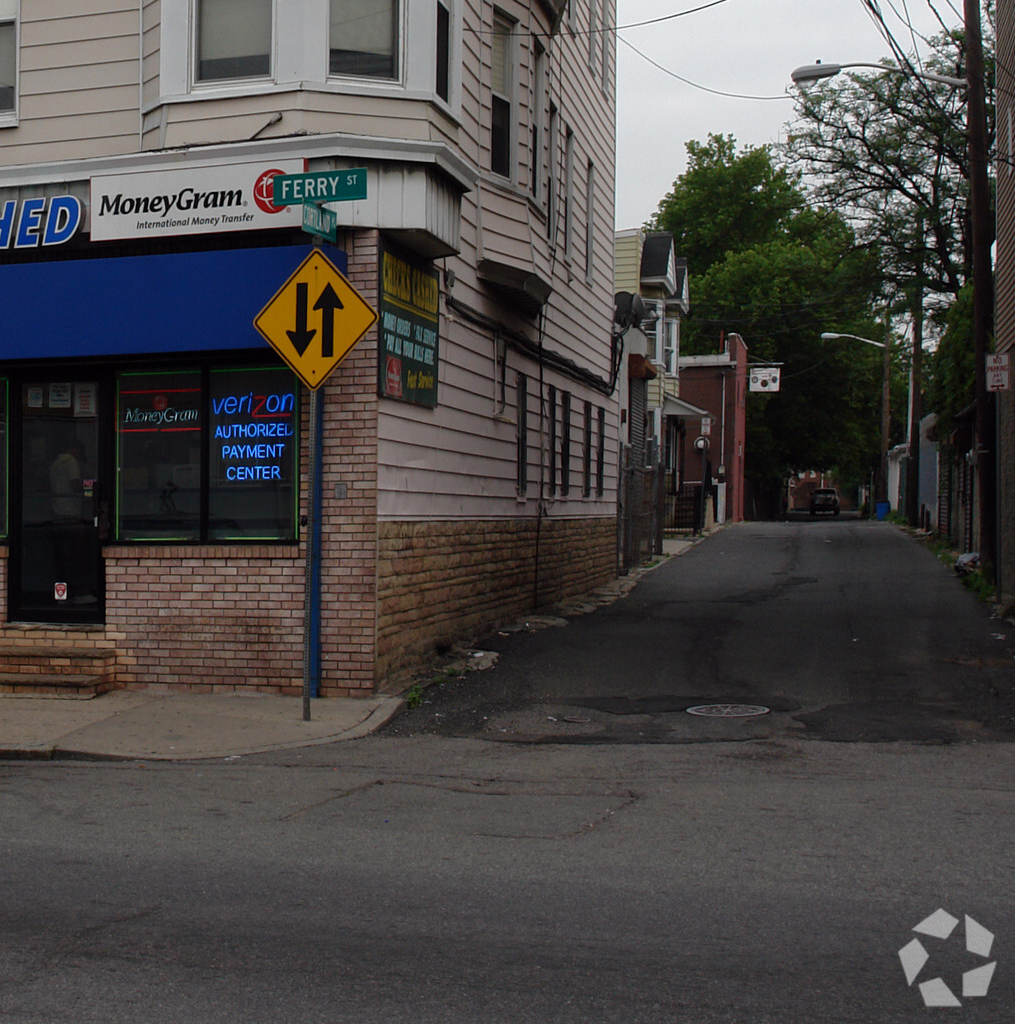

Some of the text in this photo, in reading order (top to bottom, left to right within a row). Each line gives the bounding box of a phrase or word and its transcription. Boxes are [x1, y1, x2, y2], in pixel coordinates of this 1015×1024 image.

[282, 174, 358, 199] FERRY ST
[98, 187, 243, 217] MoneyGram
[136, 213, 255, 230] International Money Transfer
[212, 391, 295, 417] verizon
[124, 407, 199, 425] MoneyGram
[214, 422, 294, 439] AUTHORIZED
[222, 443, 285, 460] PAYMENT
[226, 465, 282, 481] CENTER
